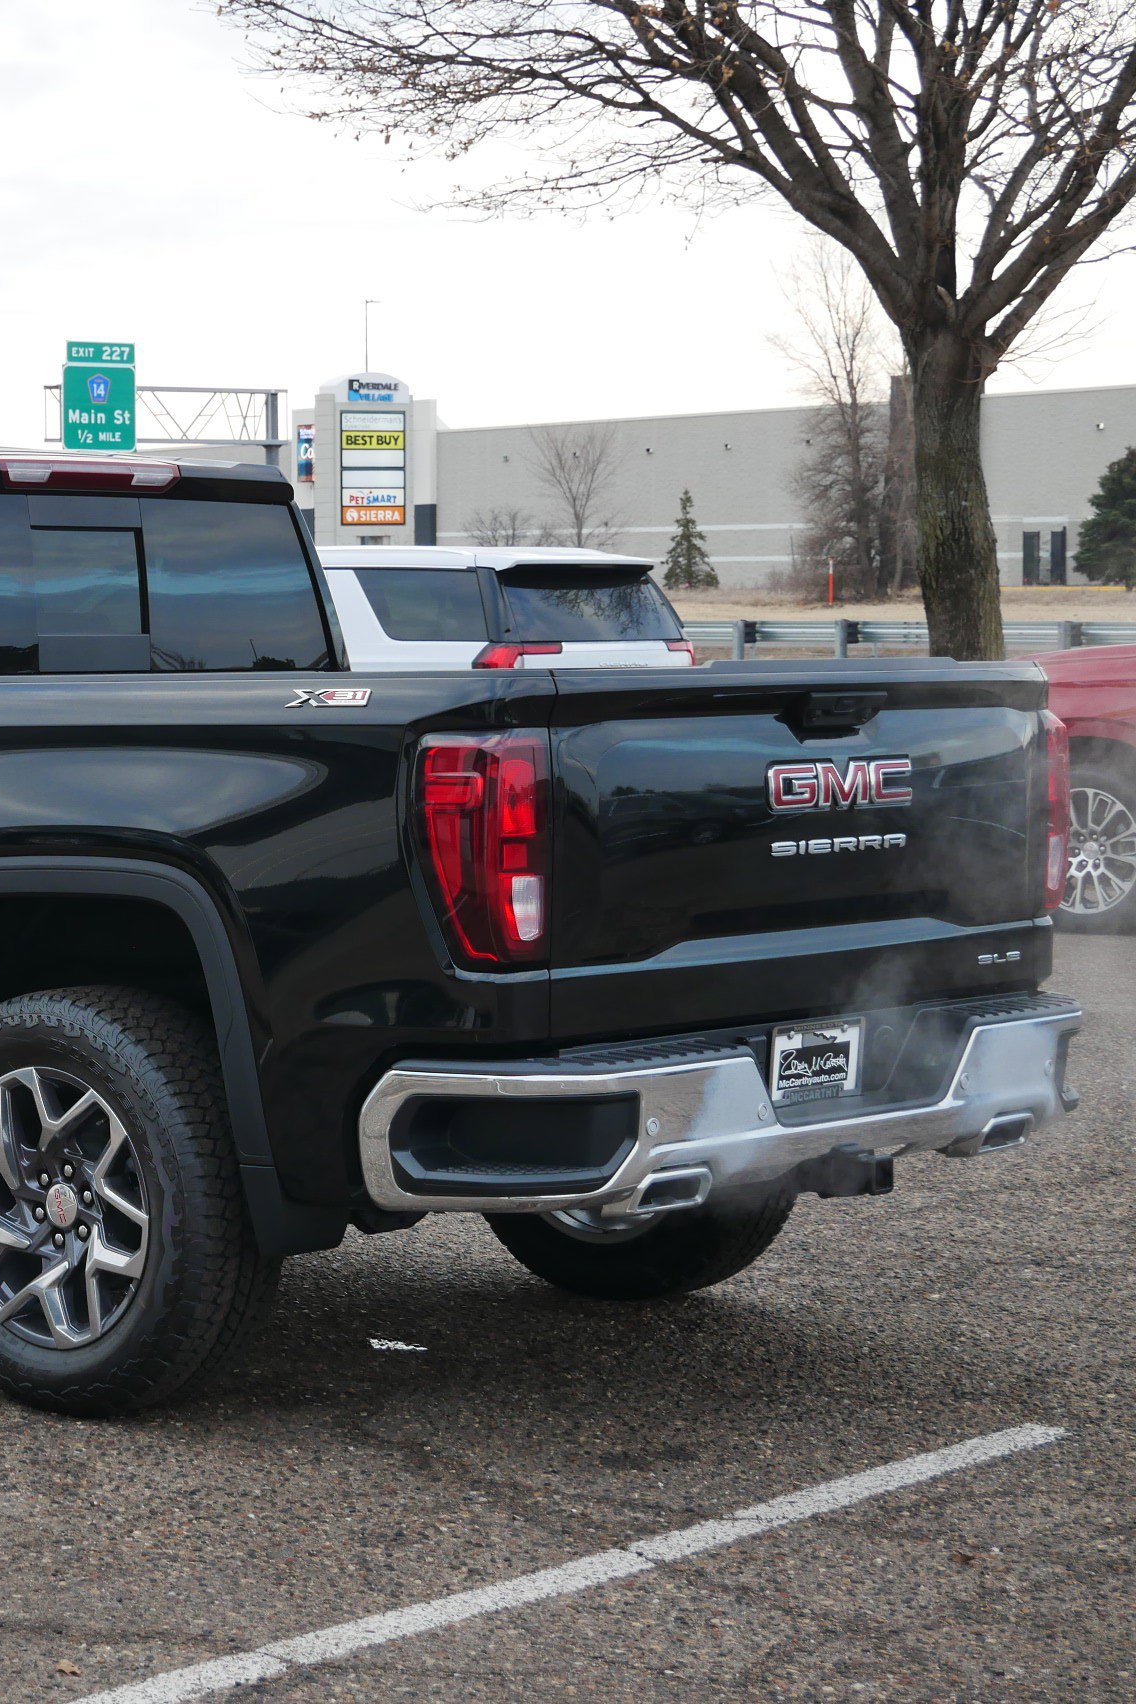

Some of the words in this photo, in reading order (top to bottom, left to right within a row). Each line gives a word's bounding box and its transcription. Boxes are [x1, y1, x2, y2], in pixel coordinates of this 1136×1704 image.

[71, 347, 94, 358] EXIT
[101, 347, 130, 361] 227
[92, 383, 106, 398] 14
[68, 409, 106, 424] Main
[113, 410, 131, 425] St
[98, 432, 122, 442] MILE
[345, 435, 374, 446] BEST
[376, 435, 400, 446] BUY
[359, 510, 400, 521] SIERRA
[285, 689, 371, 708] X31
[767, 756, 913, 813] GMC
[770, 833, 907, 857] SIERRA
[778, 1072, 846, 1089] McCarthyauto.com
[54, 1189, 67, 1223] GMC
